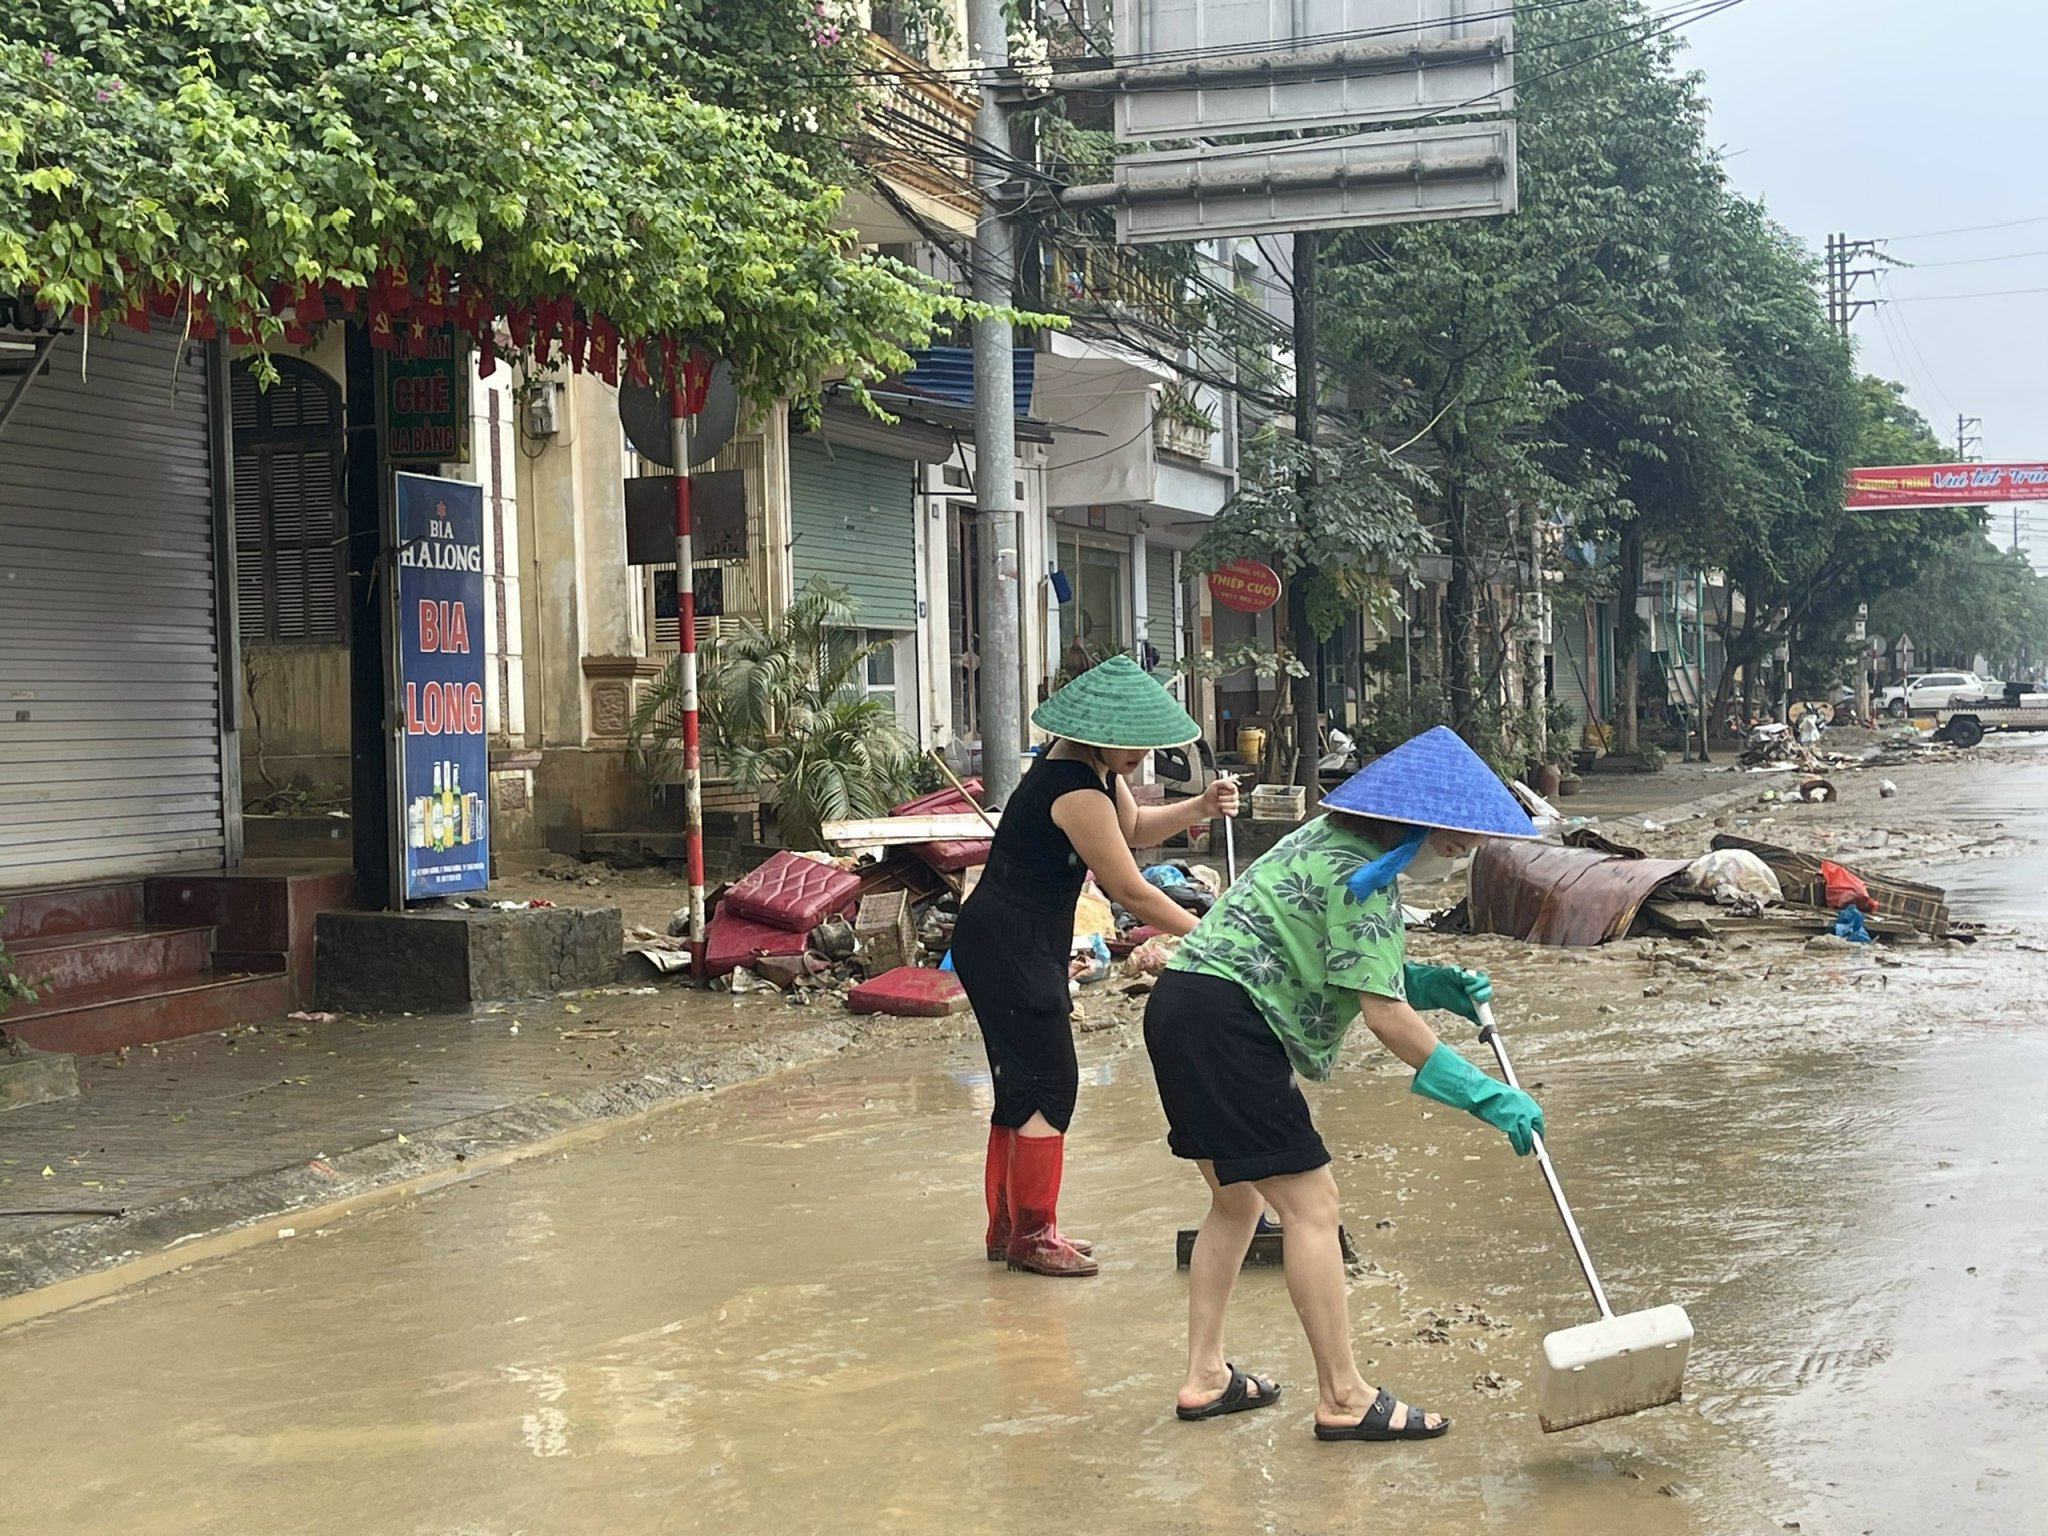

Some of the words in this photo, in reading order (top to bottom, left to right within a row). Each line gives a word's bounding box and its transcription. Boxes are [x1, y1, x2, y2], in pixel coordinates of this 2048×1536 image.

[393, 368, 450, 414] CHÈ
[390, 426, 410, 454] LA
[1933, 471, 1968, 488] Vui
[429, 520, 455, 539] BIA
[419, 599, 470, 654] BIA
[406, 681, 484, 736] LONG
